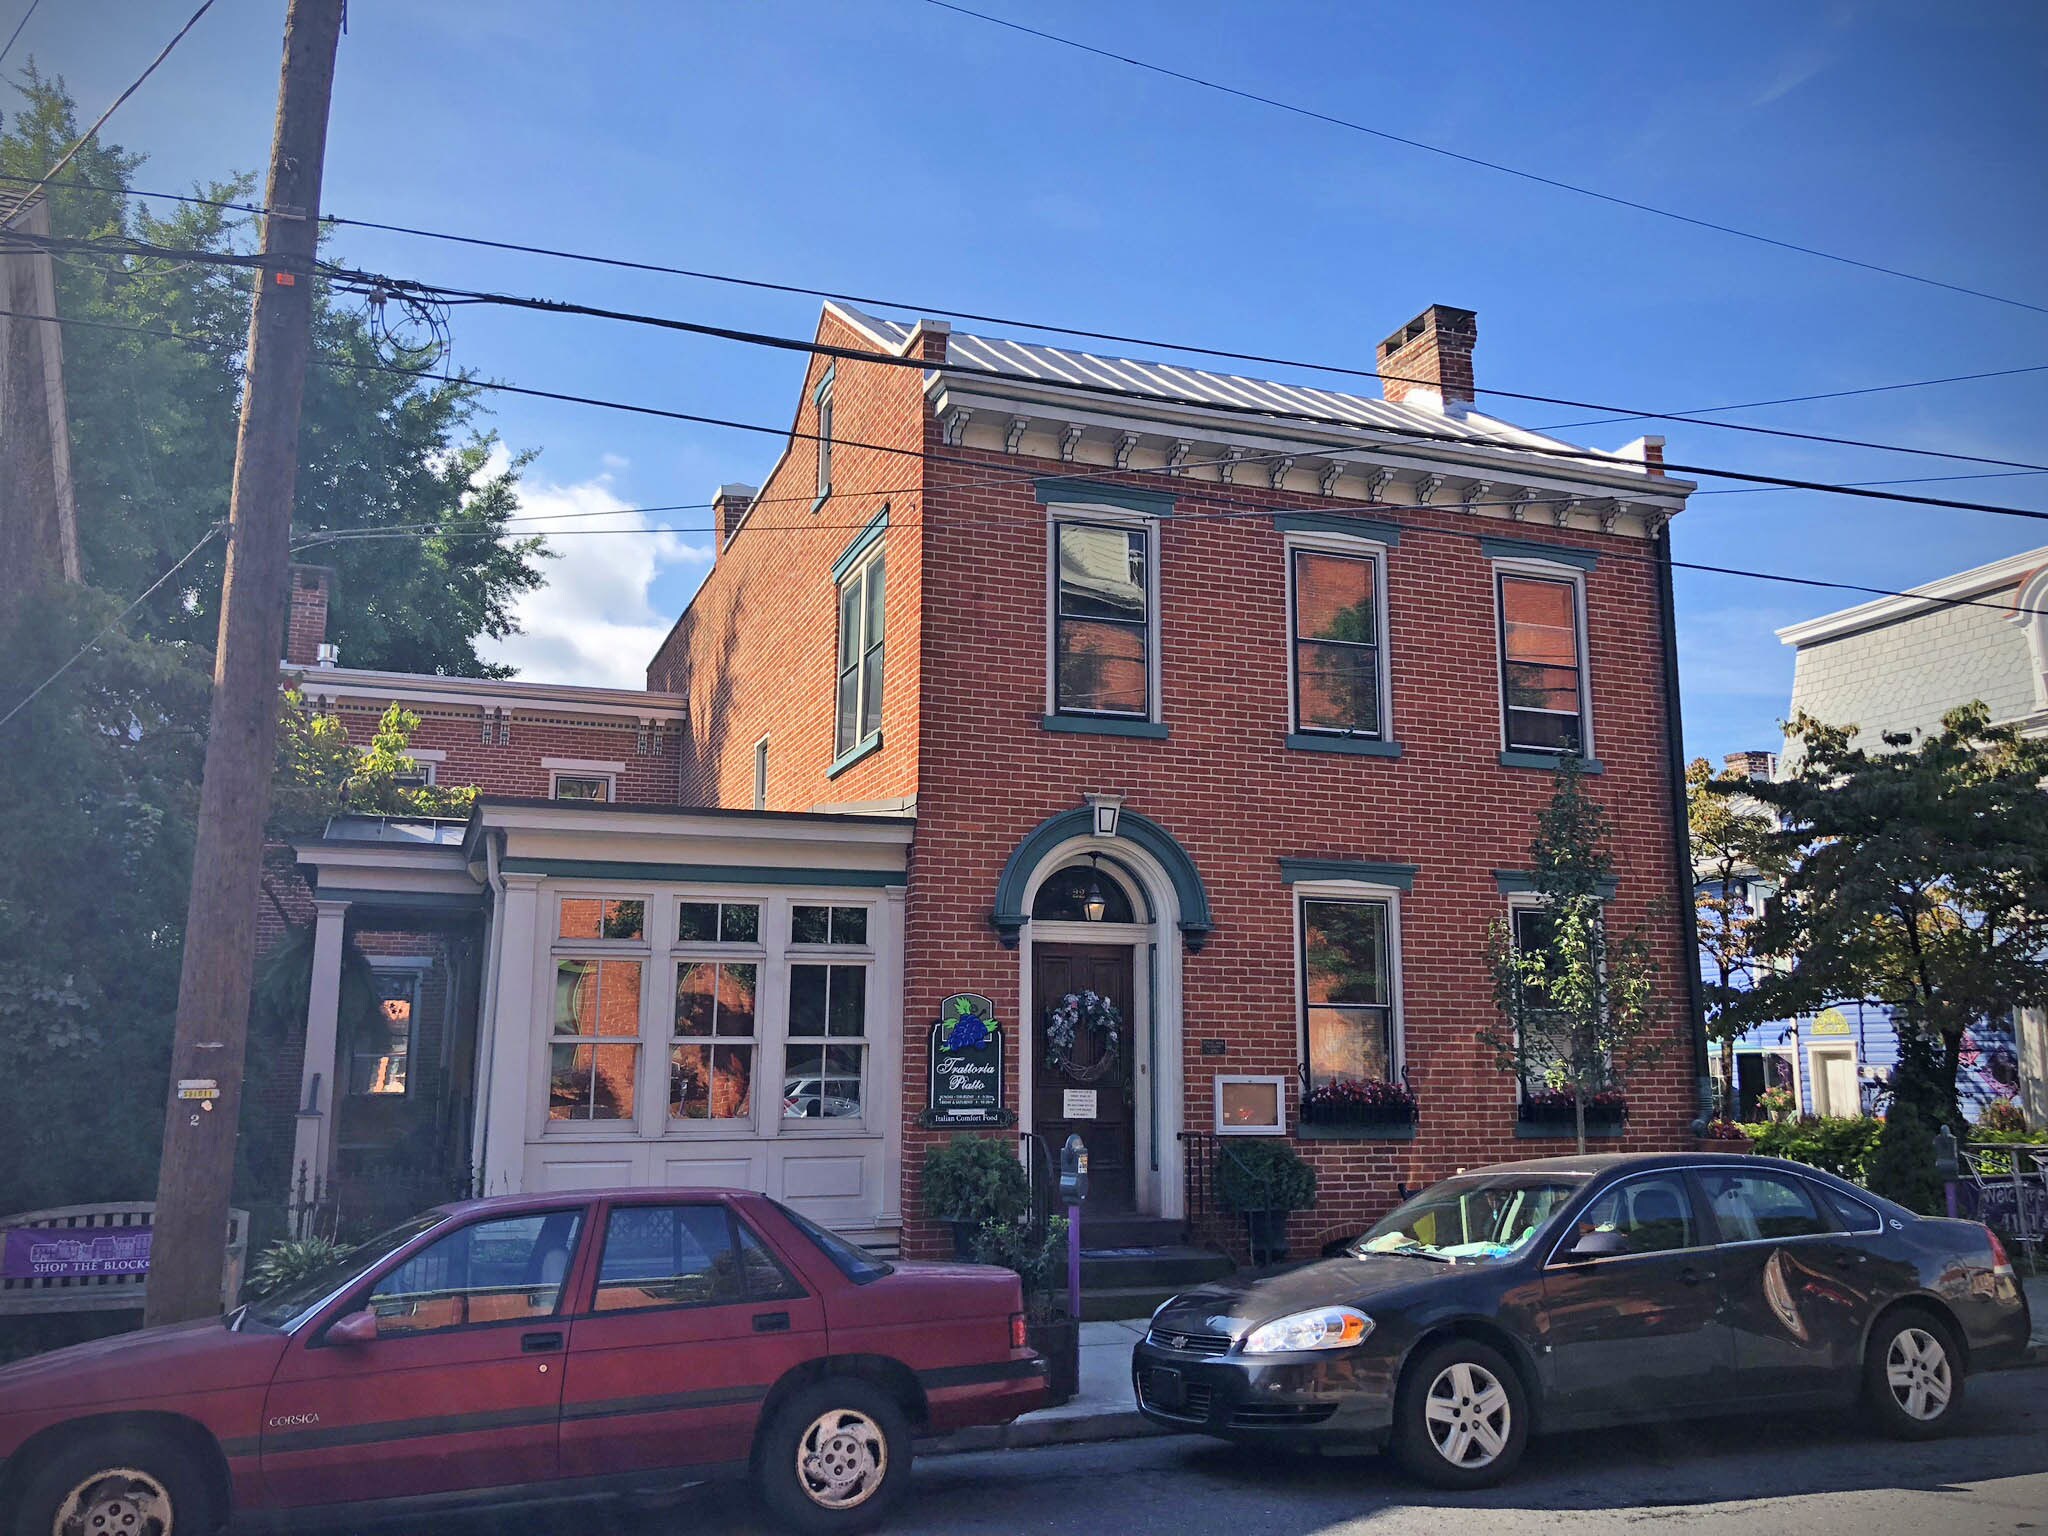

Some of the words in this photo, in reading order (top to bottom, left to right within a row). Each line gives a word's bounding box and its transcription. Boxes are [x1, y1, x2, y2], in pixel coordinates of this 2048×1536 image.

[936, 1056, 995, 1074] Trattoria
[949, 1074, 985, 1090] Piatto
[190, 1114, 200, 1126] 2
[935, 1114, 956, 1122] Italian
[982, 1113, 998, 1121] Food
[33, 1262, 68, 1273] SHOP
[72, 1261, 98, 1271] THE
[269, 1412, 320, 1427] CORSICA
